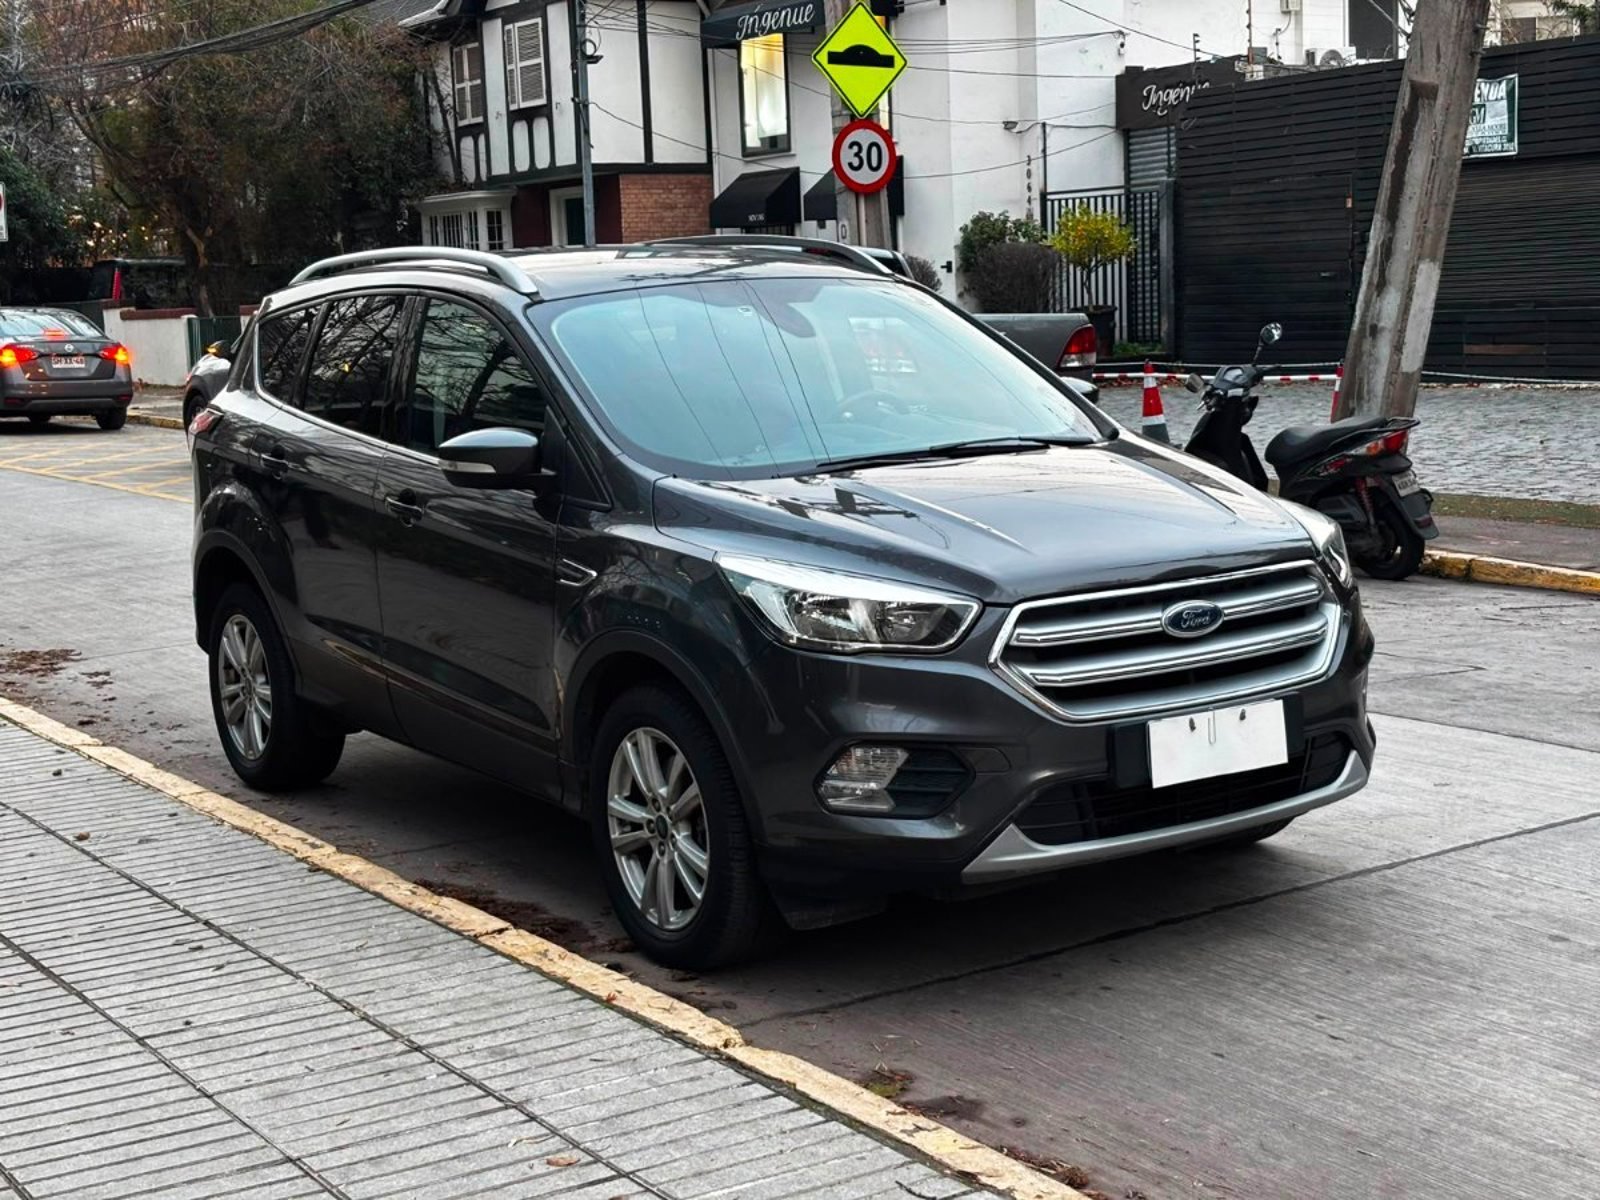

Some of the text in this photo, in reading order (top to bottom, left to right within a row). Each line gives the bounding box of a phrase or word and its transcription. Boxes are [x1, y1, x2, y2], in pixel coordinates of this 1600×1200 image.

[736, 3, 815, 40] Ingénue
[1474, 80, 1507, 104] ENDA
[847, 140, 883, 172] 30
[1181, 609, 1211, 629] Ford
